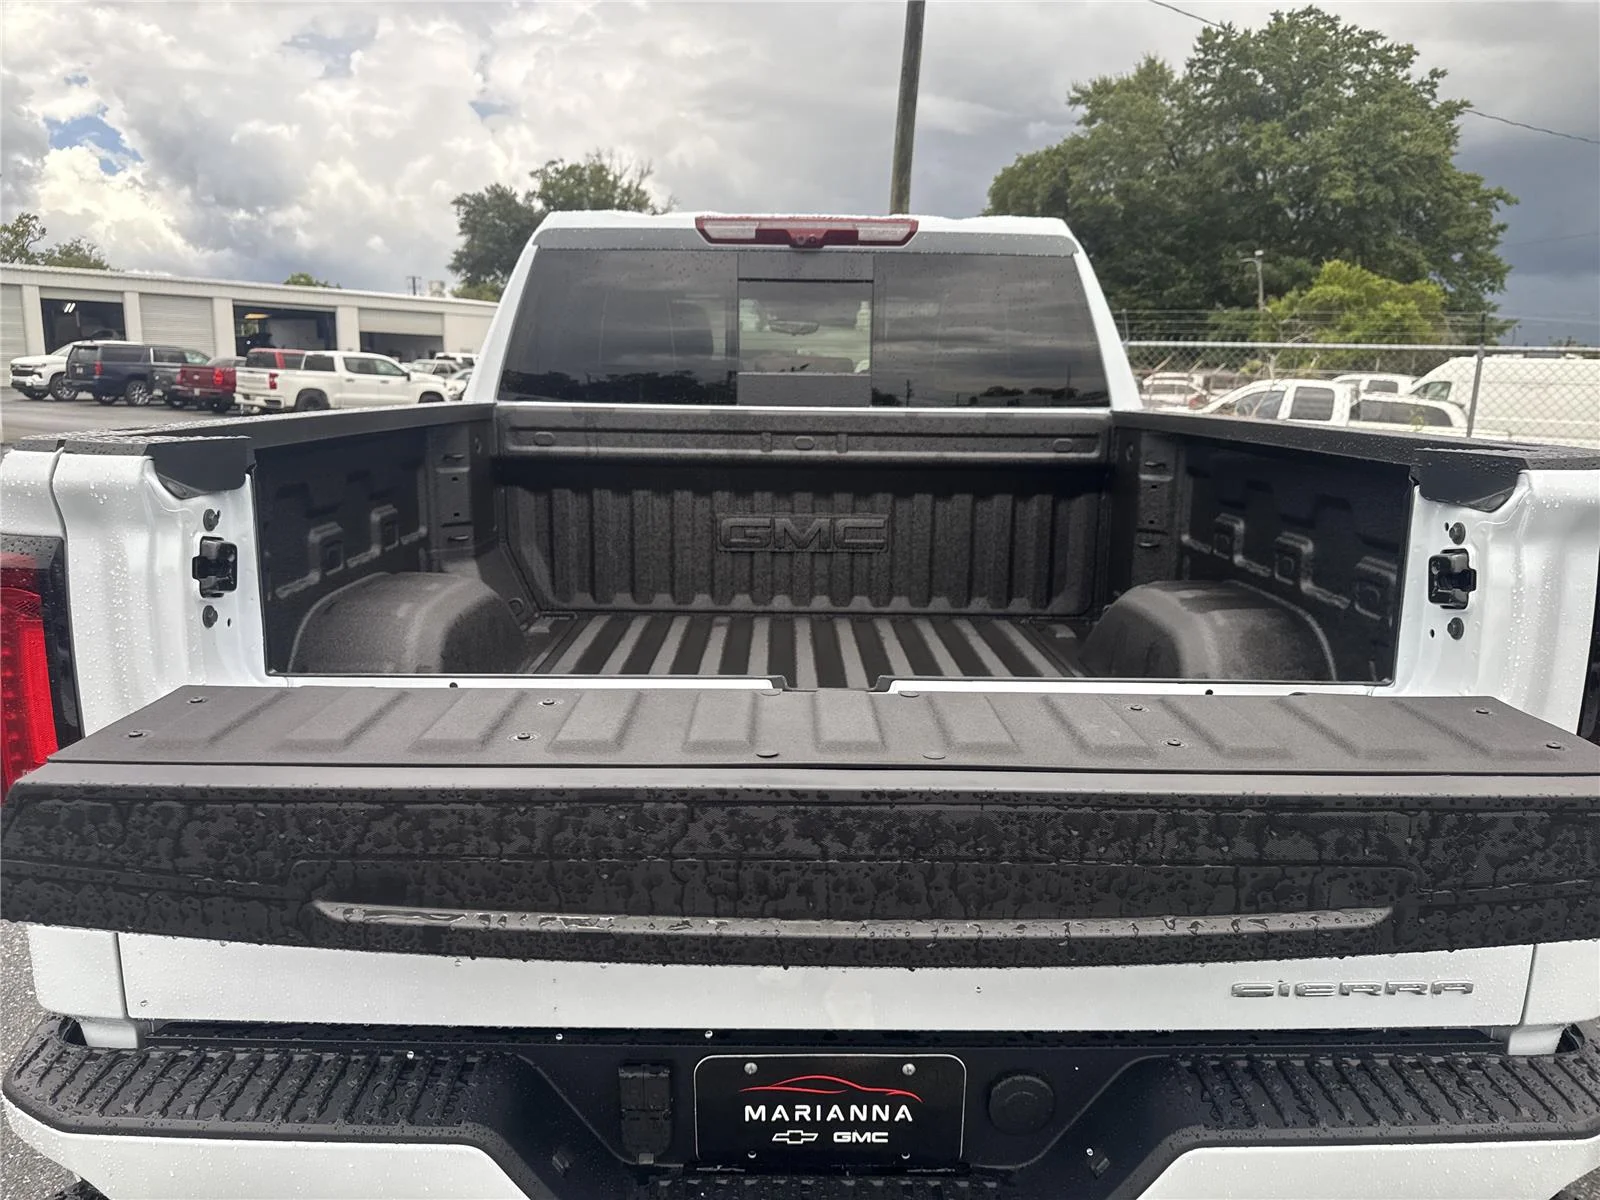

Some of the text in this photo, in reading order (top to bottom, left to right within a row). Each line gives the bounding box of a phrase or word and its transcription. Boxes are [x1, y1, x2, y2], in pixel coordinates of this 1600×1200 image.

[720, 516, 886, 550] GMC
[1231, 980, 1474, 998] SIERRA
[744, 1104, 913, 1122] MARIANNA
[833, 1131, 889, 1143] GMC
